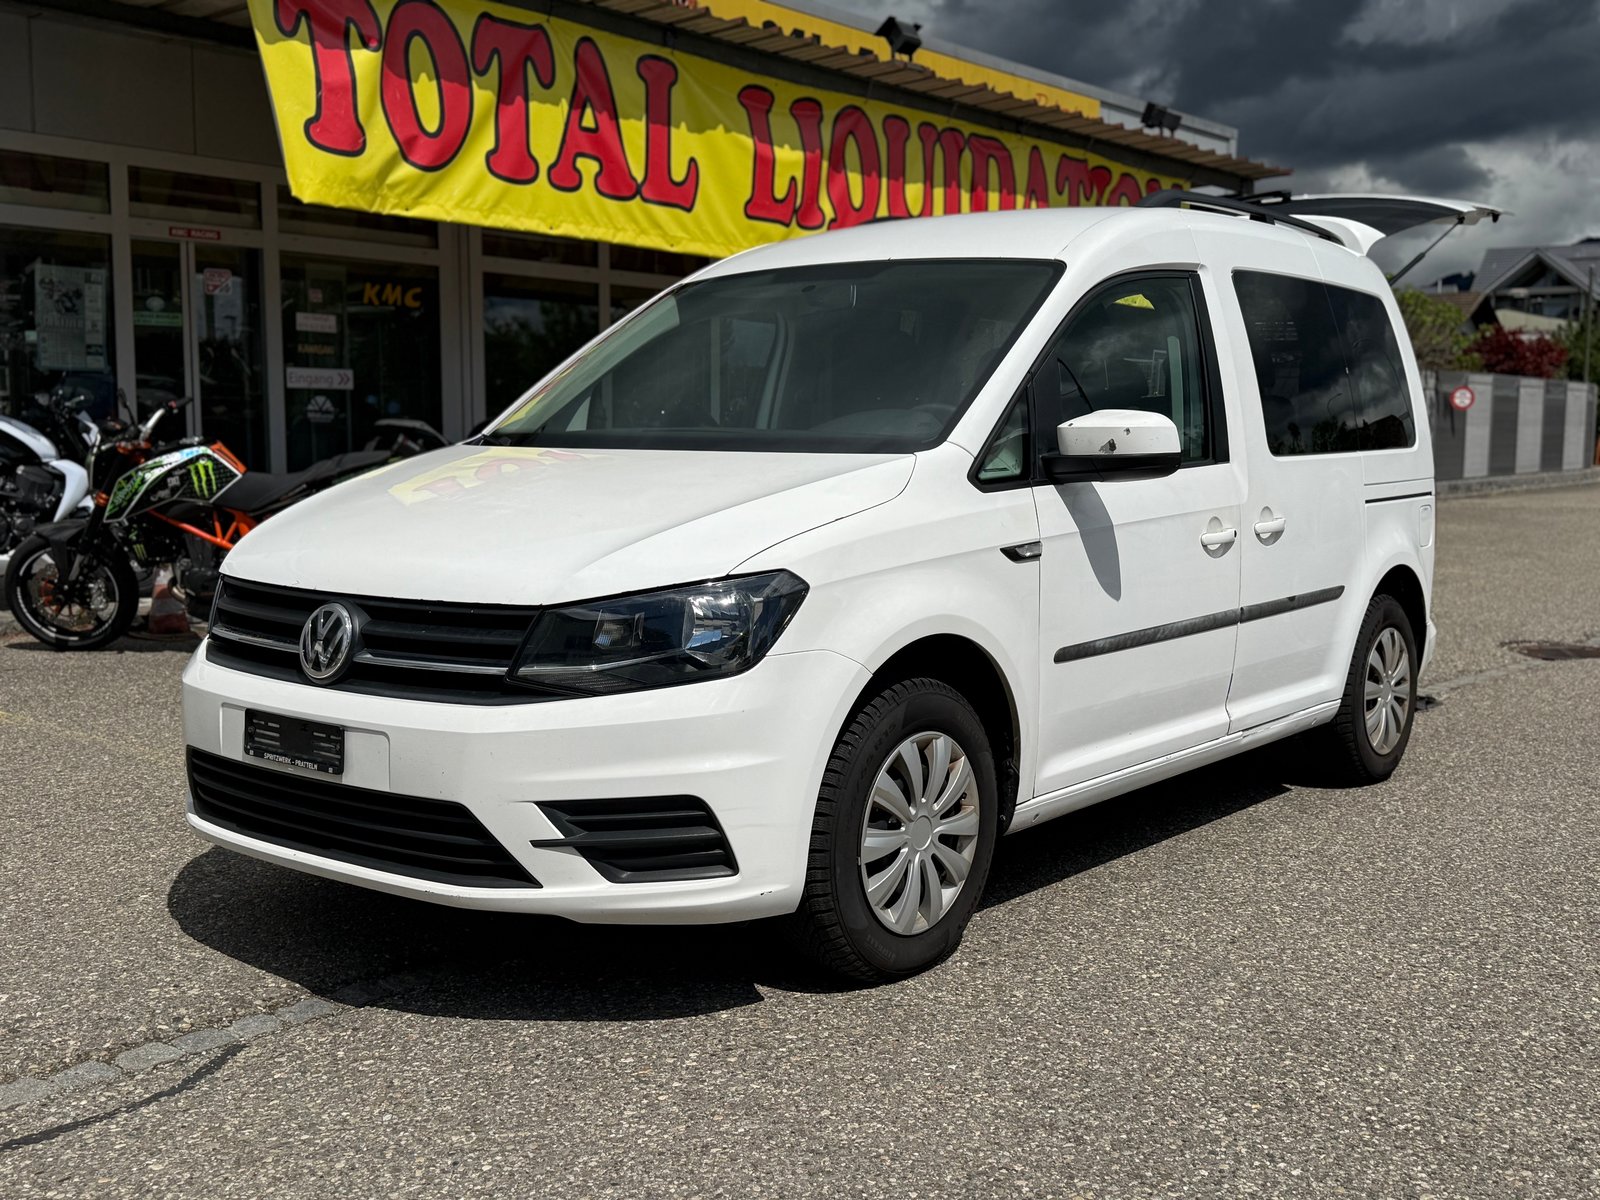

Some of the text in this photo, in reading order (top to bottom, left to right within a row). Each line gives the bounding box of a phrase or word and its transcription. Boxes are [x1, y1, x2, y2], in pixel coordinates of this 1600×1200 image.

[273, 0, 699, 213] TOTAL
[362, 282, 423, 309] KMC
[288, 371, 335, 388] Eingang
[263, 752, 292, 765] SPRITZWERK
[294, 759, 319, 770] PRATTELN
